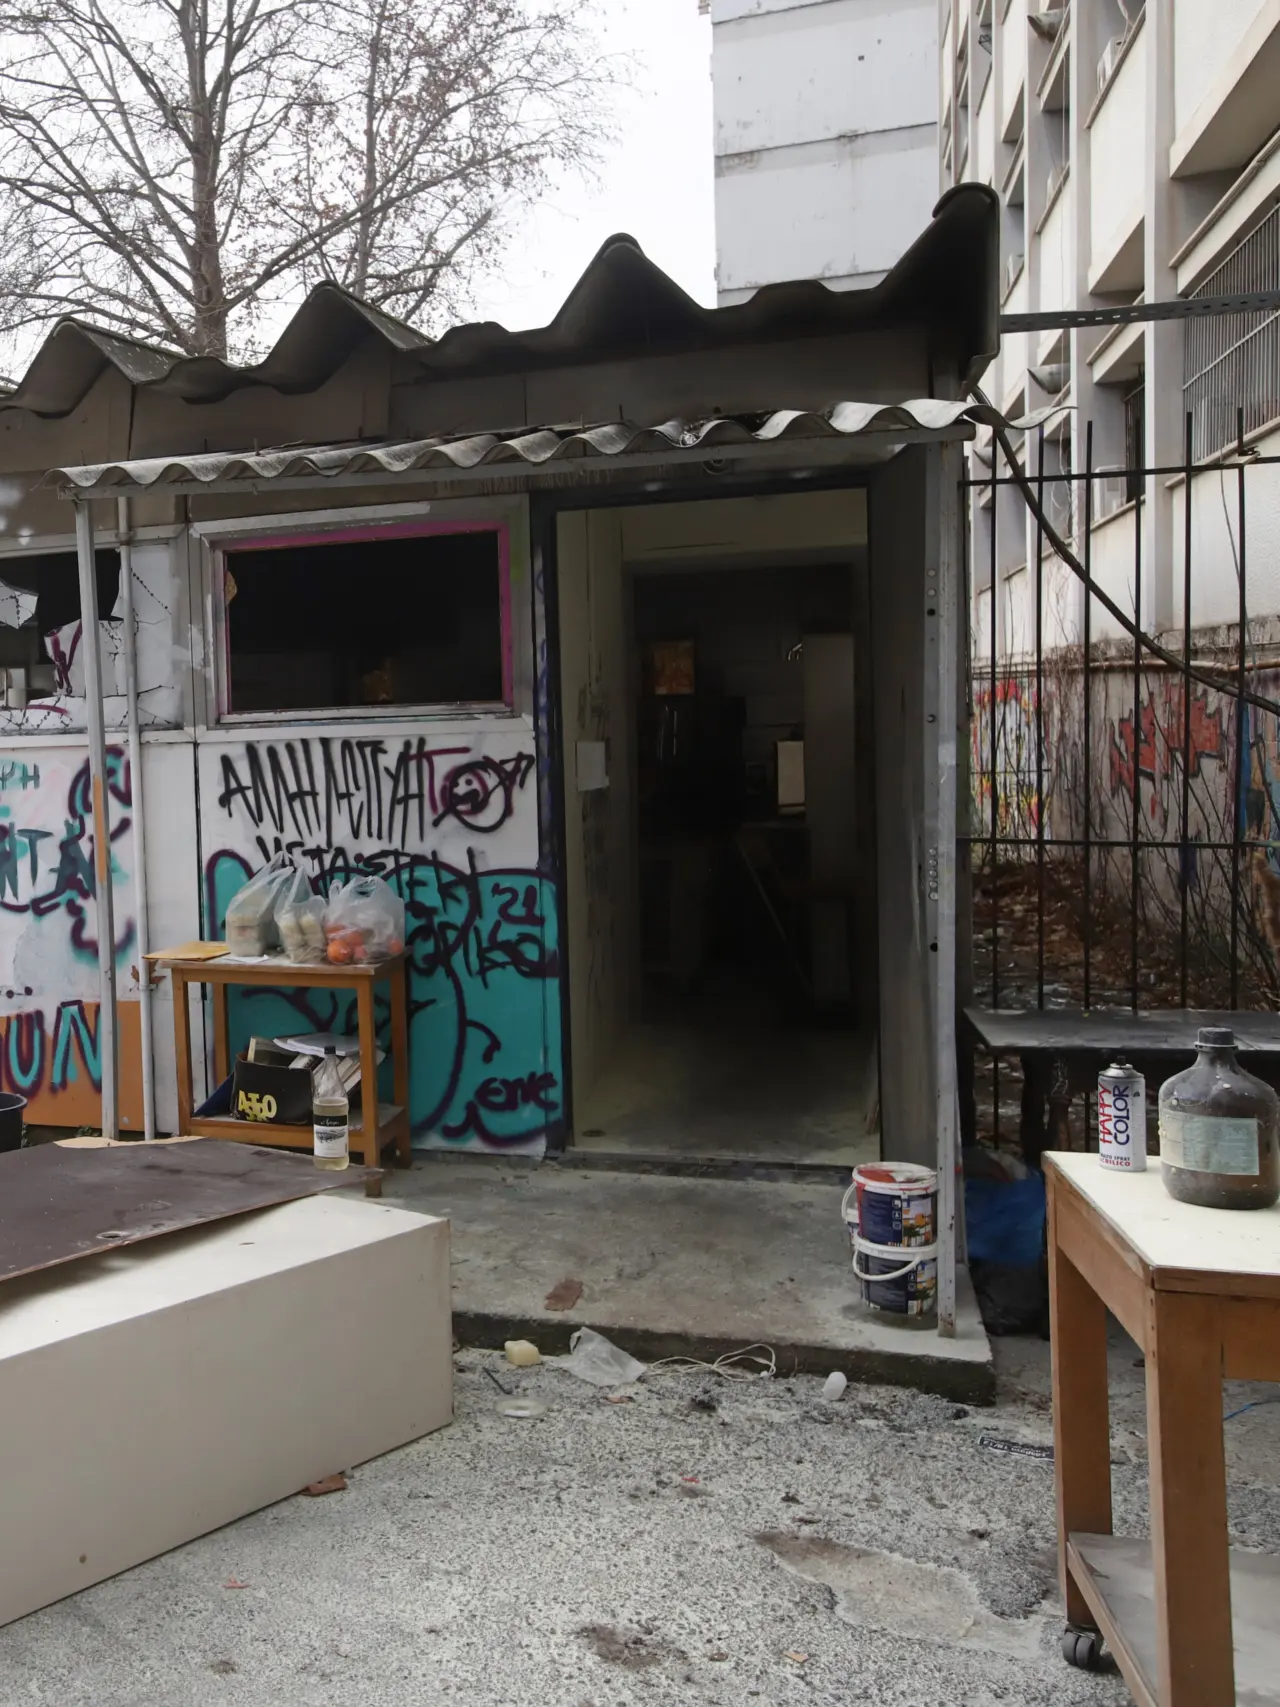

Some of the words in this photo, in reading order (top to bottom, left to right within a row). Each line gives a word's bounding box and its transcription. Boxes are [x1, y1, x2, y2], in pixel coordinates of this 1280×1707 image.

[1099, 1082, 1112, 1144] HAPPY
[1113, 1084, 1130, 1146] COLOR
[1102, 1158, 1131, 1167] RILICO
